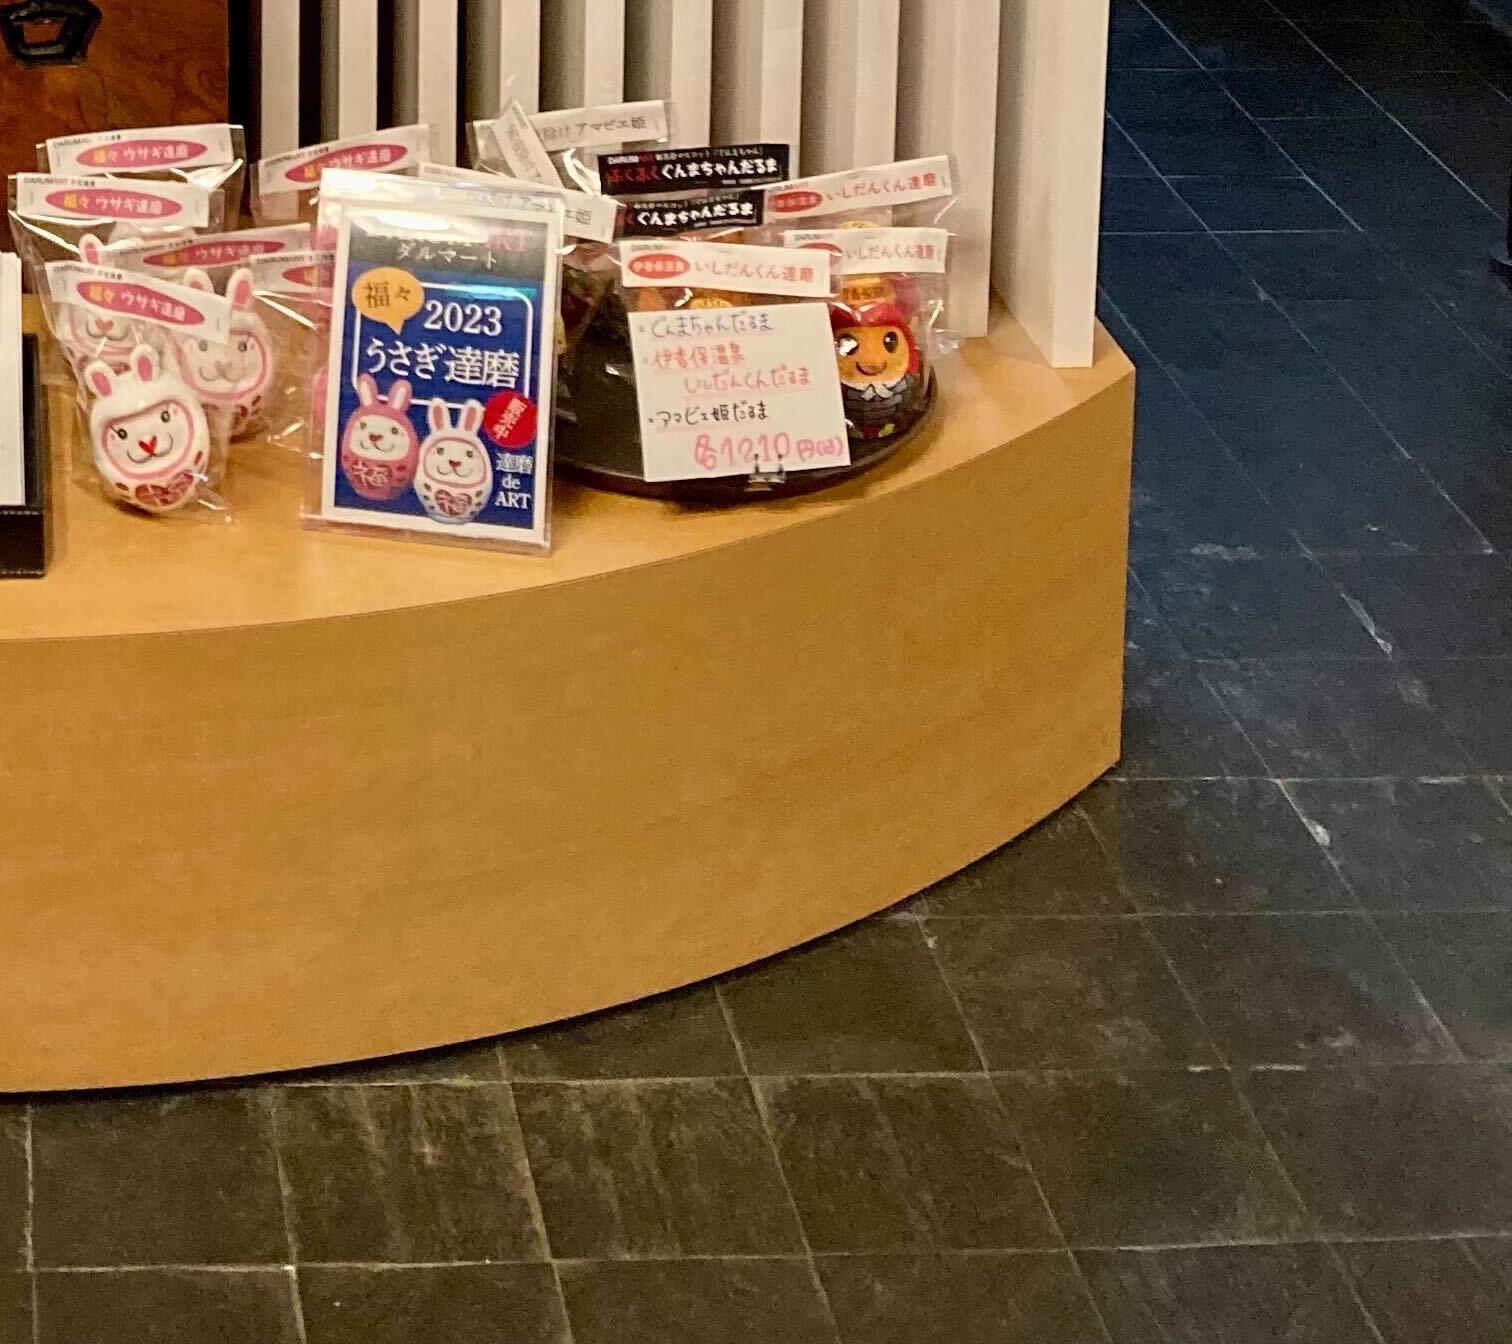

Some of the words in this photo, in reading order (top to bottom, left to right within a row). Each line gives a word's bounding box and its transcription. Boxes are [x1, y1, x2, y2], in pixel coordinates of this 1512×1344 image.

[362, 280, 413, 310] 福々
[423, 299, 503, 337] 2023
[366, 338, 521, 389] うさぎ達磨
[501, 473, 521, 490] de
[494, 491, 532, 510] ART
